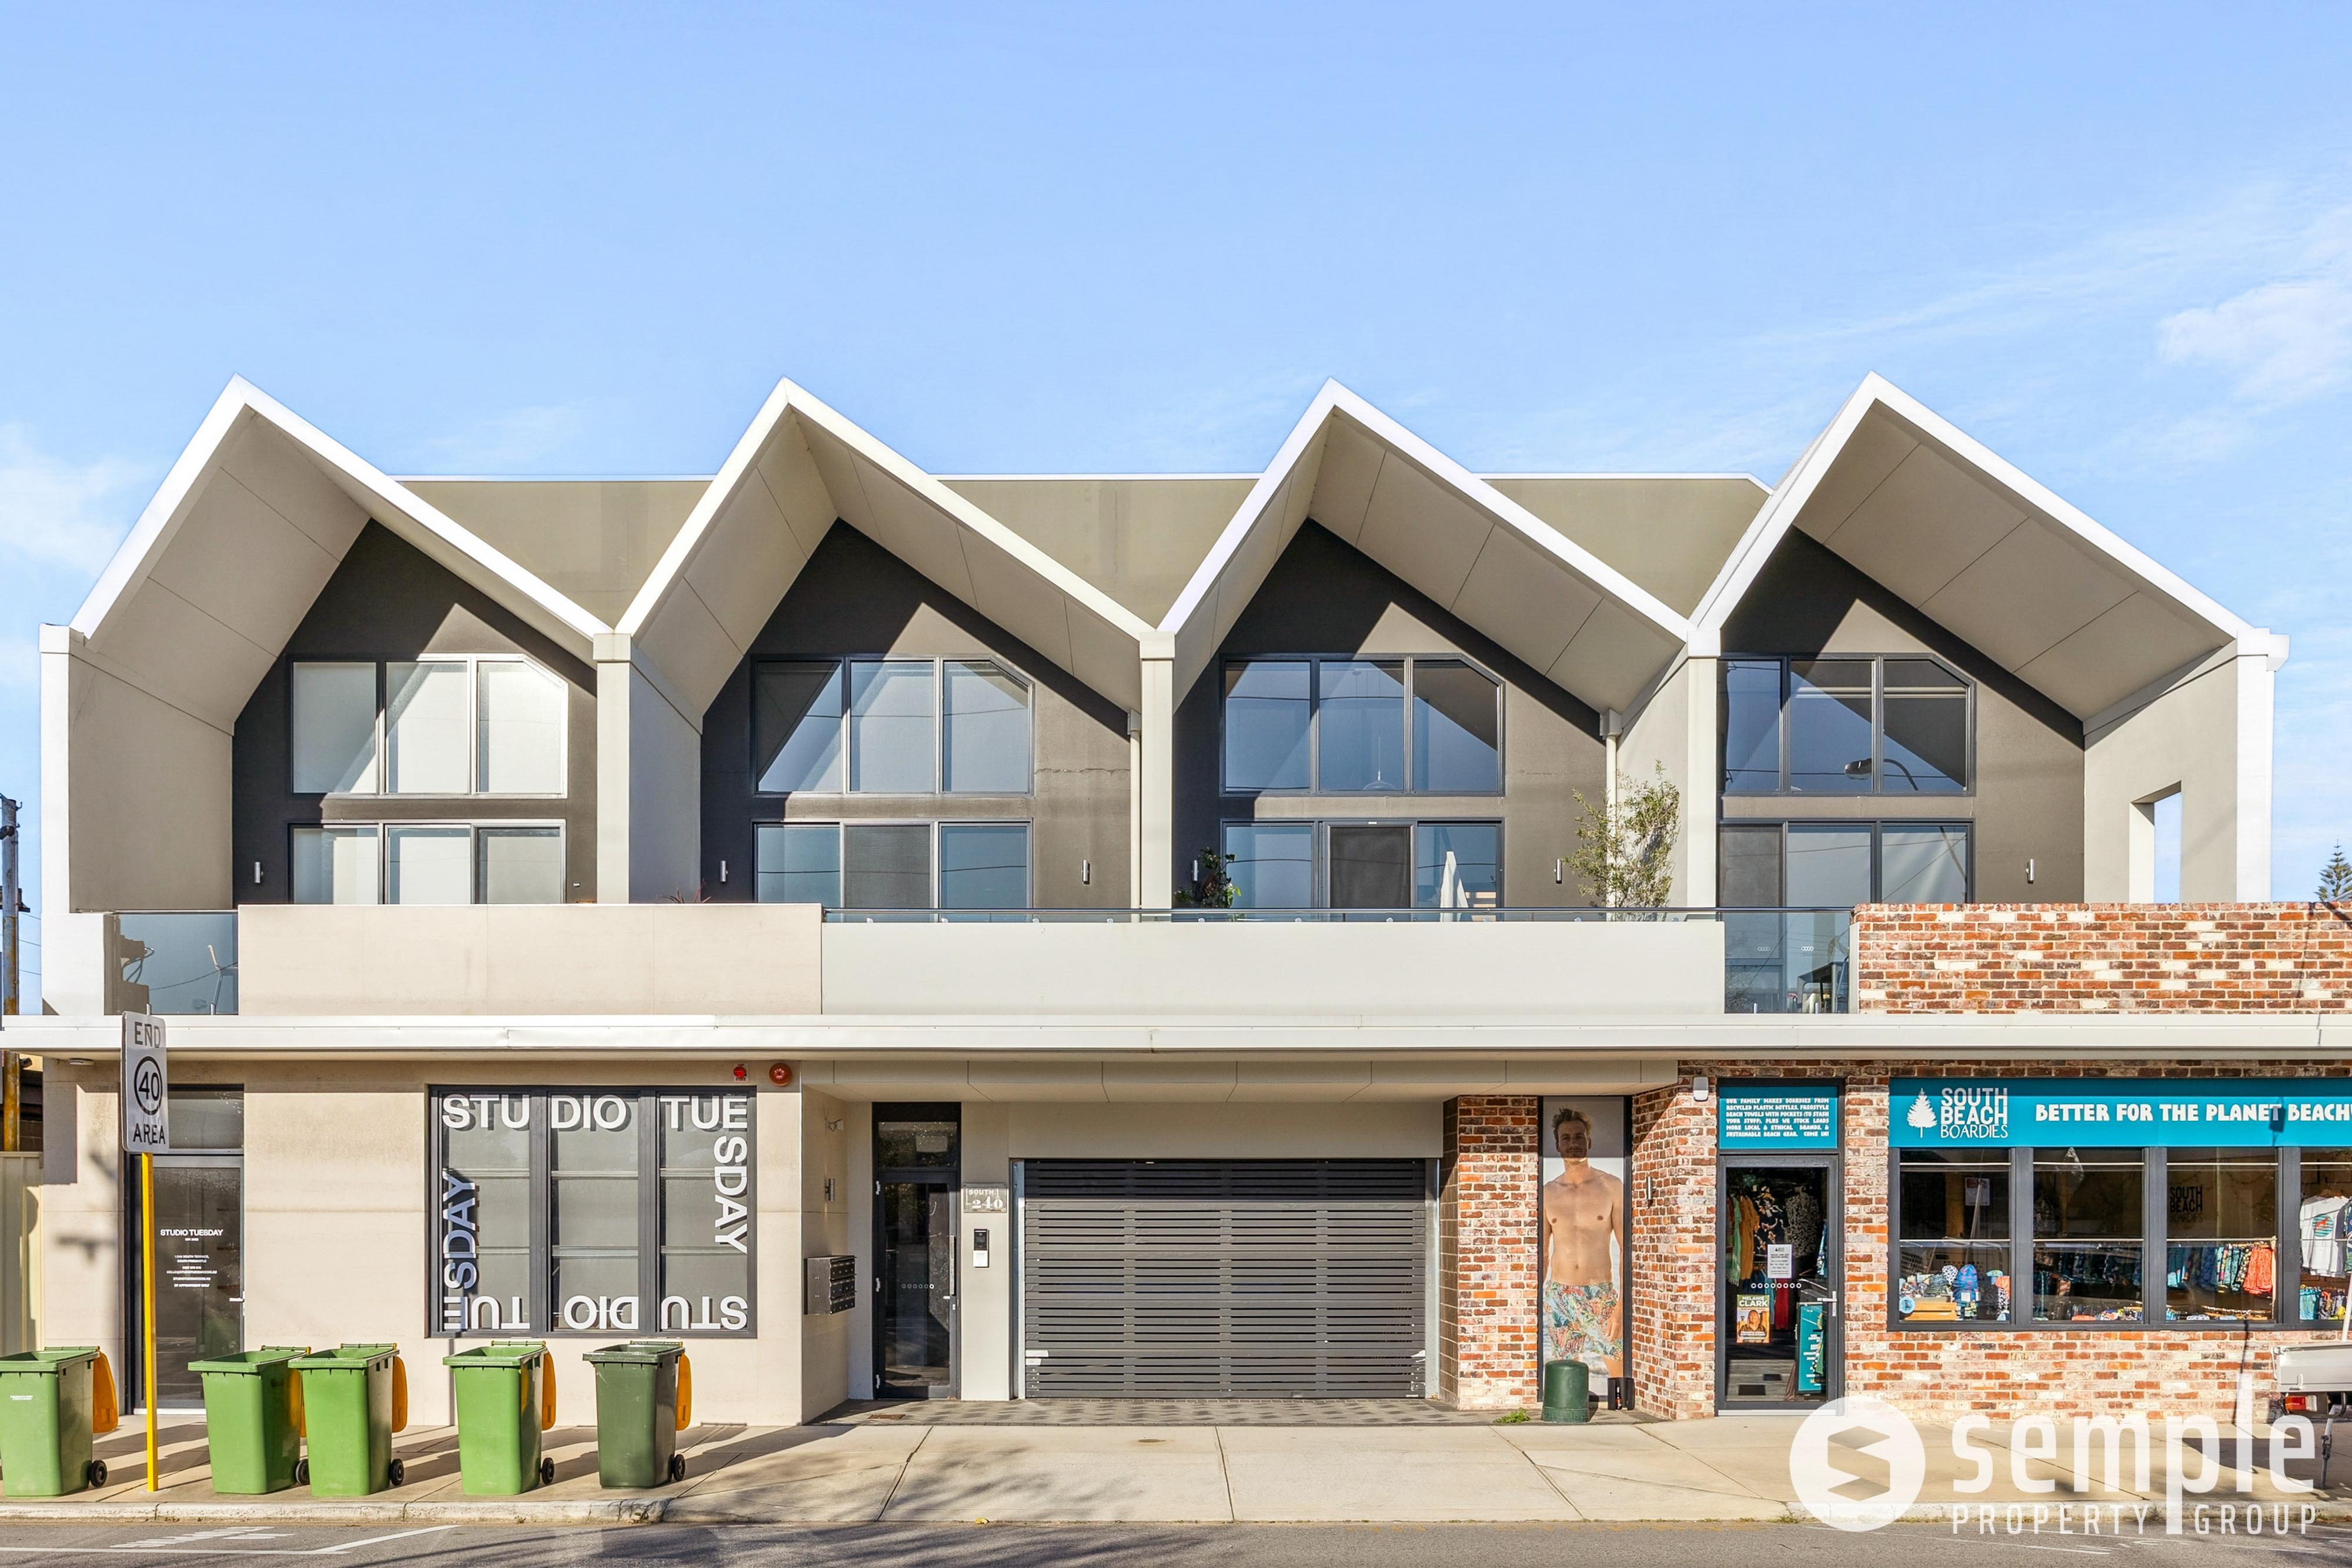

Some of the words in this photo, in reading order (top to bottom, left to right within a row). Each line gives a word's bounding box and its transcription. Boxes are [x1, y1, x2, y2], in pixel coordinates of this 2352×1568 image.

[135, 1021, 161, 1048] END
[138, 1071, 160, 1101] 40
[1941, 1087, 2007, 1106] SOUTH
[1941, 1106, 2007, 1125] BEACH
[2036, 1104, 2110, 1121] BETTER
[2116, 1104, 2153, 1121] FOR
[2159, 1104, 2198, 1121] THE
[2206, 1104, 2282, 1121] PLANET
[2288, 1104, 2352, 1121] BEACH
[133, 1123, 166, 1145] AREA
[1940, 1124, 2009, 1139] BOARDIES
[2170, 1186, 2203, 1199] SOUTH
[972, 1196, 1004, 1209] 240
[2170, 1199, 2203, 1212] BEACH
